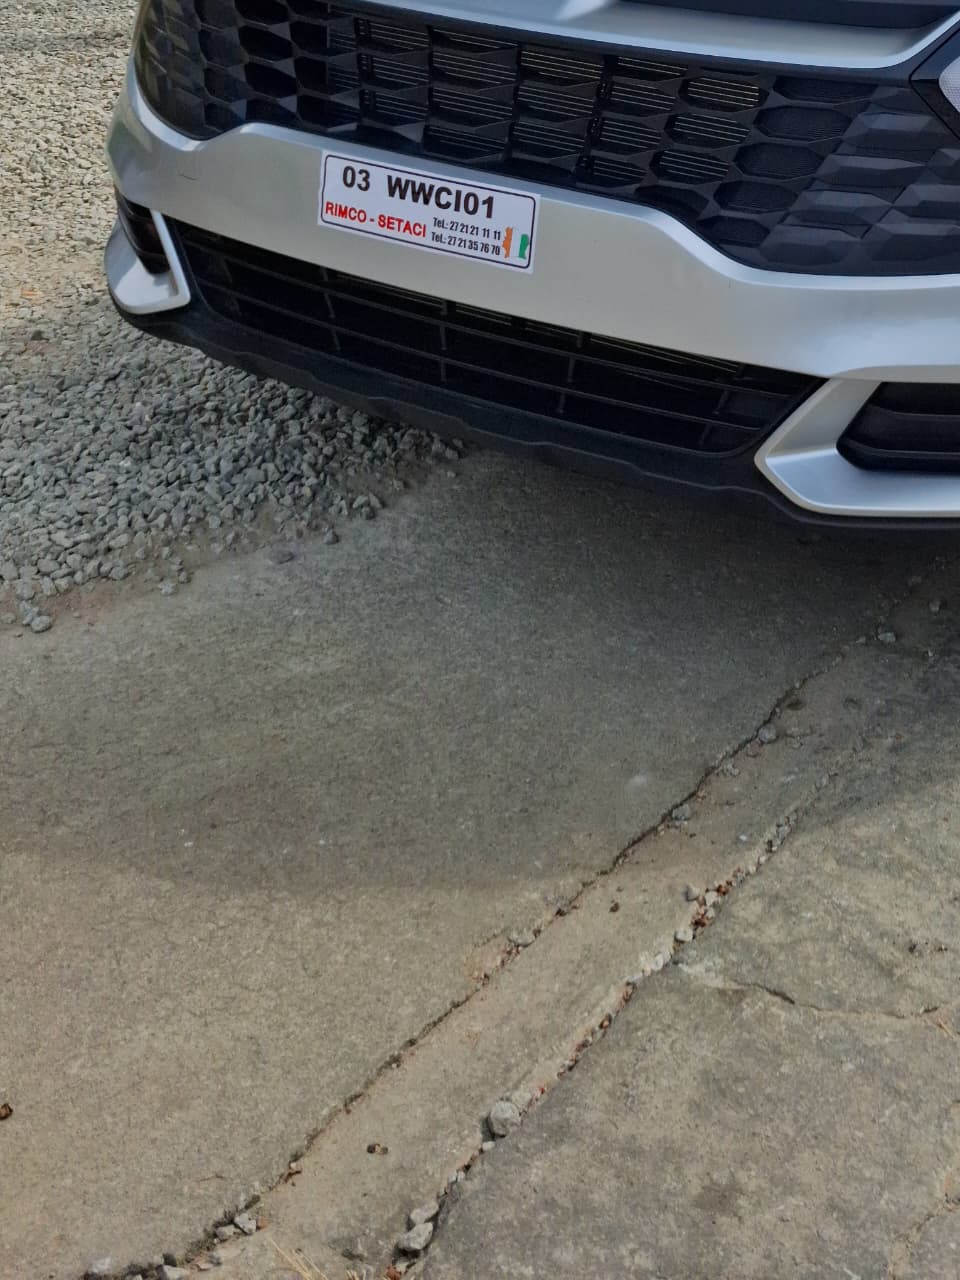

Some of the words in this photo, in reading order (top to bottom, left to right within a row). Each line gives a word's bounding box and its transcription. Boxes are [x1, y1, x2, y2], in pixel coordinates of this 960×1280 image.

[342, 166, 371, 192] 03
[386, 174, 494, 219] WWCI01
[325, 201, 367, 223] RIMCO
[377, 214, 427, 238] SETACI
[449, 220, 459, 232] 27
[460, 222, 469, 234] 21
[470, 225, 479, 236] 21
[482, 227, 490, 239] 11
[447, 235, 457, 247] 27
[458, 237, 467, 249] 21
[468, 240, 479, 252] 35
